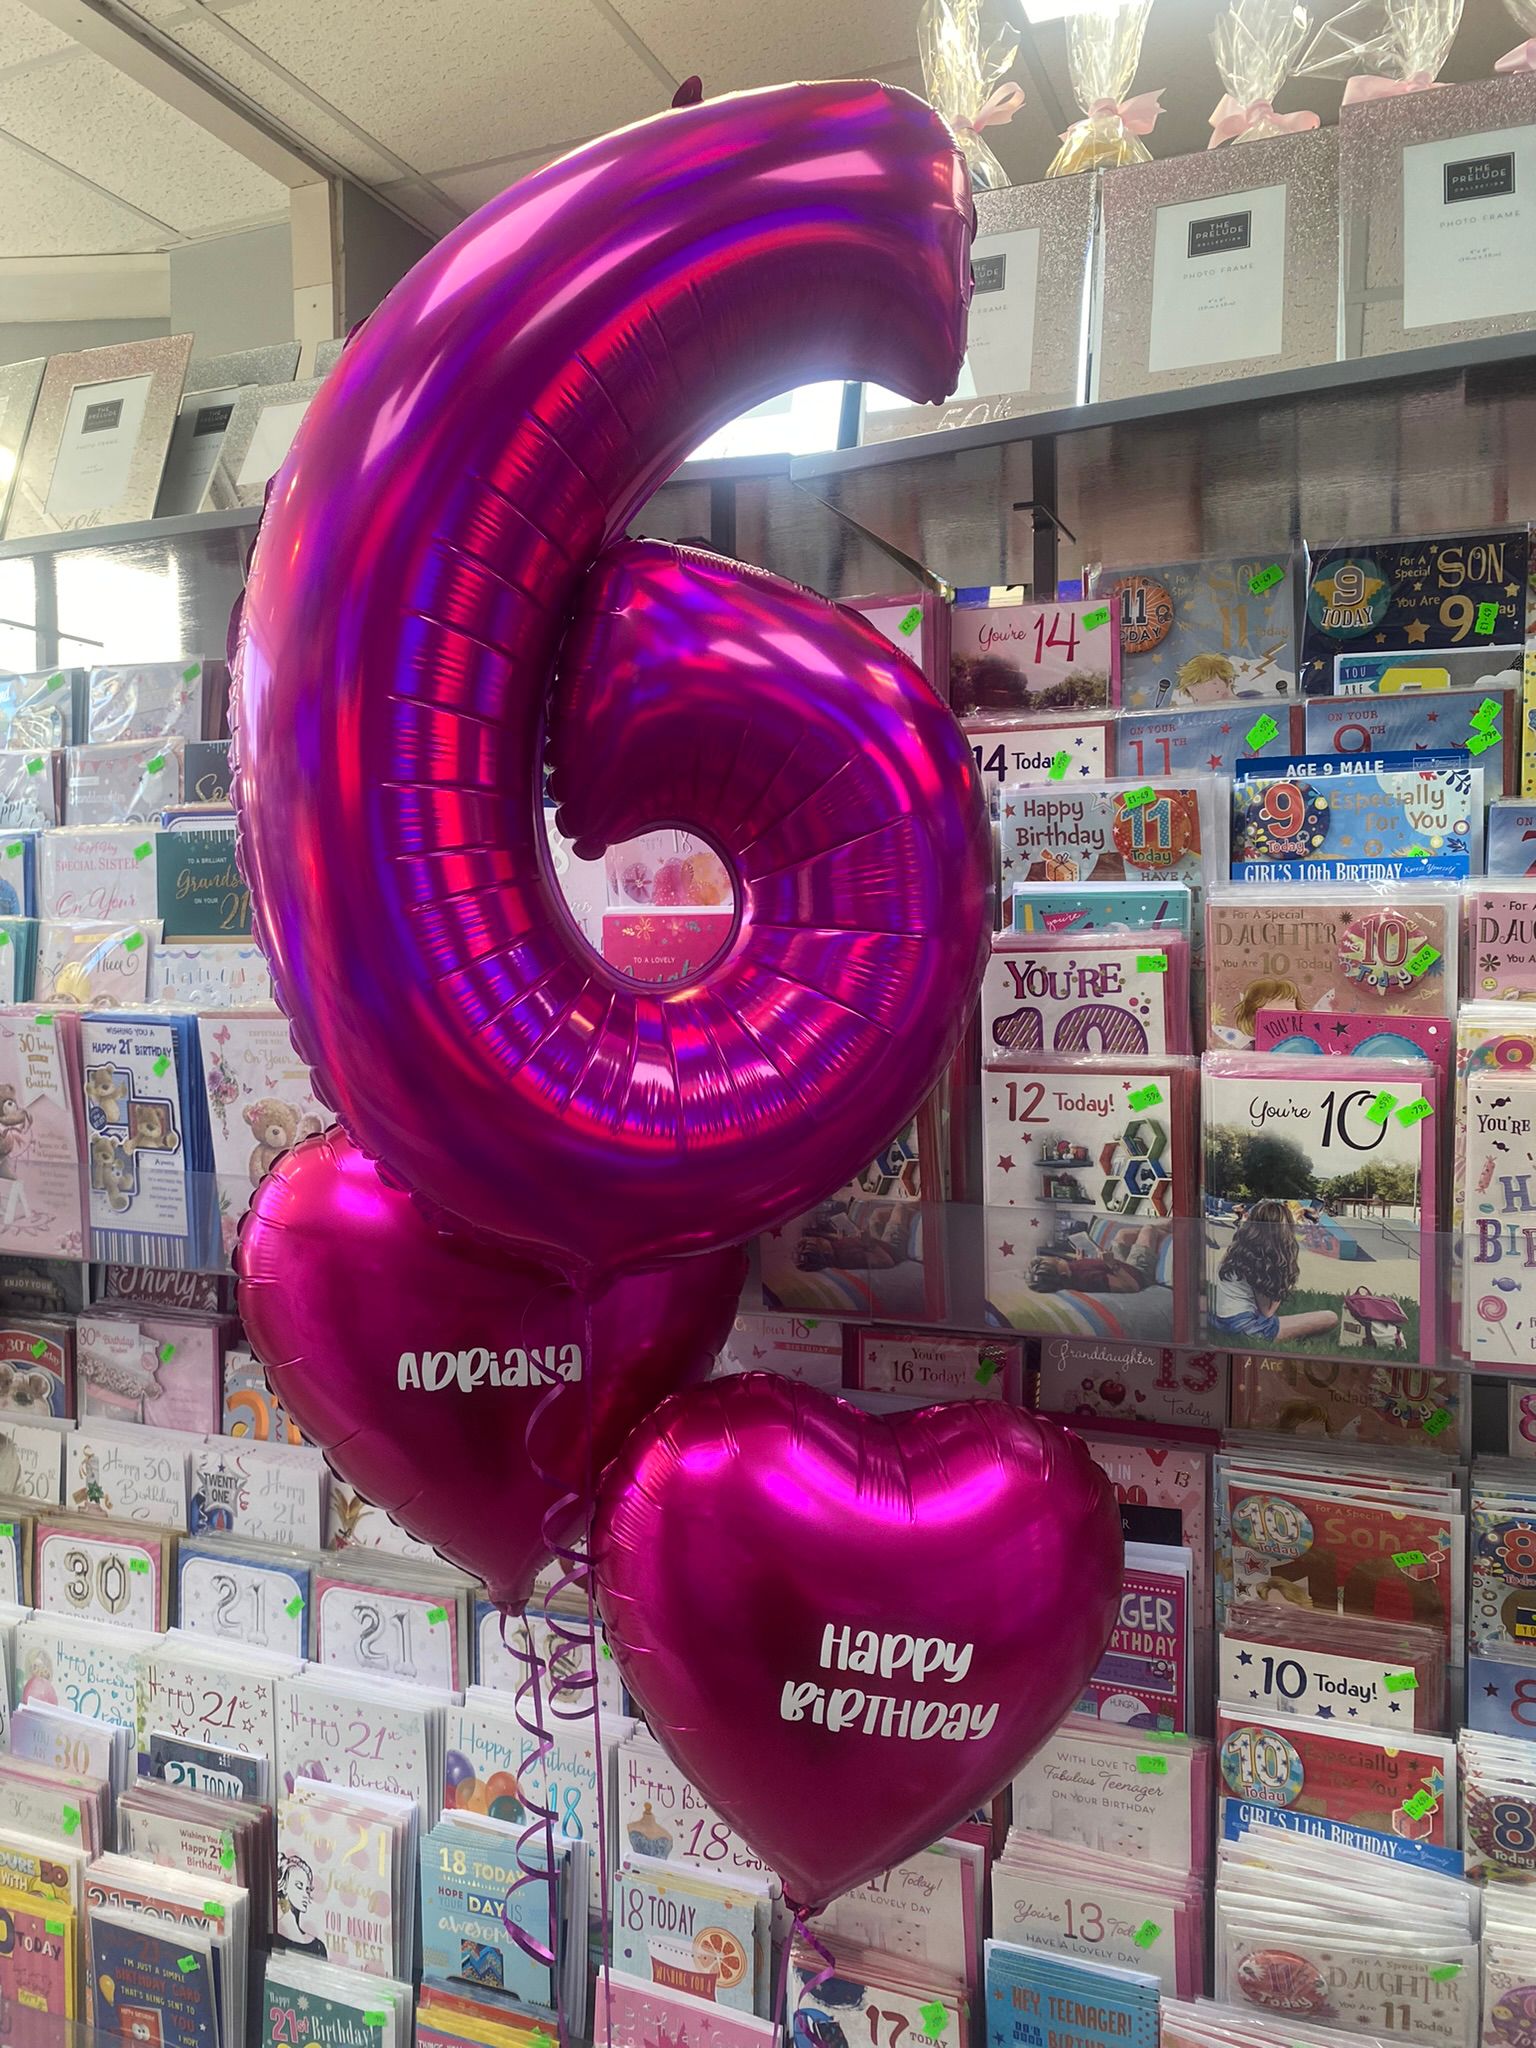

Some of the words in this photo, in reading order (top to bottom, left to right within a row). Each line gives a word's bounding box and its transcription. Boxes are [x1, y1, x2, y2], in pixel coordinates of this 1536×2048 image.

[1452, 168, 1506, 184] PRELUDE
[1468, 163, 1490, 173] THE
[1211, 221, 1229, 230] THE
[1440, 217, 1476, 228] PHOTO
[1483, 210, 1520, 220] FRAME
[1195, 226, 1243, 239] PRELUDE
[1183, 269, 1215, 279] PHOTO
[1221, 263, 1253, 272] FRAME
[1395, 566, 1430, 580] Special
[1400, 557, 1415, 565] For
[1437, 543, 1506, 588] SON
[1333, 566, 1365, 606] 9
[1321, 607, 1373, 627] TODAY
[1397, 597, 1417, 607] You
[1420, 596, 1440, 605] Are
[1440, 595, 1474, 642] 9
[979, 624, 1026, 651] You're
[1034, 612, 1080, 663] 14
[1345, 666, 1366, 677] YOU
[1345, 685, 1363, 694] ARE
[1346, 711, 1378, 720] YOUR
[1130, 725, 1149, 736] ON
[1152, 724, 1176, 734] YOUR
[1287, 763, 1319, 777] AGE
[1323, 762, 1333, 775] 9
[1340, 760, 1383, 774] MALE
[1331, 785, 1444, 810] Especially
[1024, 800, 1083, 826] Happy
[1264, 783, 1305, 838] 9
[1365, 812, 1399, 832] For
[1410, 811, 1447, 829] You
[1517, 817, 1532, 825] ON
[1121, 800, 1171, 848] 11
[1016, 827, 1105, 849] Birthday
[1267, 840, 1305, 853] Today
[56, 859, 96, 872] SPECIAL
[1131, 849, 1171, 864] Today
[1142, 872, 1179, 881] HAVE
[1245, 865, 1292, 881] GIRL'S
[1299, 865, 1330, 881] 10th
[1336, 863, 1403, 881] BIRTHDAY
[1232, 911, 1247, 919] For
[1265, 910, 1304, 922] Special
[1509, 901, 1528, 910] For
[1217, 922, 1337, 951] DAUGHTER
[1361, 919, 1408, 967] 10
[1222, 960, 1238, 968] You
[1260, 952, 1290, 975] 10
[1296, 959, 1333, 972] Today
[1507, 954, 1524, 963] You
[1004, 960, 1122, 1000] YOU'RE
[1357, 966, 1413, 988] Today
[106, 1028, 132, 1036] WISHING
[135, 1028, 148, 1036] YOU
[1264, 1016, 1303, 1038] YOU'RE
[93, 1043, 116, 1053] HAPPY
[135, 1046, 171, 1057] BIRTHDAY
[1005, 1082, 1050, 1122] 12
[1053, 1092, 1115, 1117] Today!
[1249, 1096, 1311, 1127] You're
[1320, 1090, 1387, 1151] 10
[1477, 1115, 1530, 1135] YOU'RE
[5, 1280, 28, 1288] ENJOY
[103, 1335, 134, 1346] Birthday
[785, 1344, 829, 1352] BIRTHDAY
[1049, 1339, 1158, 1372] Granddaughter
[891, 1361, 914, 1383] 16
[919, 1366, 966, 1385] Today!
[1162, 1395, 1211, 1425] Today
[103, 1449, 141, 1479] Happy
[204, 1473, 240, 1489] TWENTY
[259, 1471, 305, 1503] Happy
[117, 1479, 179, 1516] Birthday
[211, 1489, 229, 1501] ONE
[1239, 1503, 1300, 1543] 10
[1316, 1504, 1331, 1513] For
[1347, 1509, 1384, 1520] Special
[1324, 1518, 1400, 1551] Son
[1258, 1542, 1298, 1556] Today
[64, 1551, 131, 1615] 30
[209, 1575, 267, 1646] 21
[352, 1602, 417, 1678] 21
[57, 1640, 86, 1675] Happy
[820, 1623, 974, 1683] Happy
[87, 1664, 135, 1702] Birthday
[149, 1665, 195, 1717] Happy
[1262, 1657, 1307, 1698] 10
[1314, 1673, 1377, 1703] Today!
[291, 1694, 339, 1746] Happy
[460, 1717, 512, 1768] Happy
[1057, 1752, 1086, 1763] WITH
[1091, 1759, 1118, 1769] LOVE
[1123, 1762, 1136, 1772] TO
[1228, 1732, 1289, 1788] 10
[203, 1775, 239, 1800] TODAY
[628, 1760, 674, 1808] Happy
[1043, 1765, 1096, 1785] Fabulous
[1098, 1771, 1164, 1802] Teenager
[1243, 1785, 1286, 1806] Today
[1052, 1790, 1067, 1799] ON
[1072, 1794, 1097, 1805] YOUR
[1102, 1798, 1155, 1814] BIRTHDAY
[180, 1829, 205, 1843] Wishing
[683, 1820, 732, 1860] 18
[1239, 1805, 1286, 1828] GIRL'S
[1331, 1822, 1398, 1858] BIRTHDAY
[181, 1841, 207, 1855] Happy
[187, 1857, 222, 1874] Birthday
[439, 1847, 466, 1875] 18
[473, 1862, 527, 1883] TODAY
[438, 1886, 464, 1899] HOPE
[899, 1868, 943, 1896] Today!
[469, 1897, 505, 1917] DAY
[620, 1886, 643, 1931] 18
[648, 1896, 696, 1936] TODAY
[871, 1895, 906, 1909] LOVELY
[911, 1904, 931, 1914] DAY
[325, 1910, 342, 1931] YOU
[347, 1917, 383, 1944] DESERVE
[1064, 1899, 1105, 1942] 13
[15, 1931, 60, 1960] TODAY
[326, 1933, 348, 1952] THE
[355, 1945, 384, 1962] BEST
[1026, 1933, 1055, 1947] HAVE
[1073, 1943, 1113, 1958] LOVELY
[1118, 1953, 1141, 1964] DAY
[137, 1961, 152, 1973] JUST
[163, 1970, 185, 1983] SIMPLE
[656, 1966, 687, 1987] WISHING
[1352, 1958, 1371, 1967] For
[1386, 1961, 1428, 1973] Special
[121, 1986, 143, 1999] THAT'S
[168, 2000, 182, 2011] SENT
[1259, 1993, 1313, 2009] Today
[866, 2004, 909, 2048] 17
[1048, 1996, 1132, 2038] TEENAGER!
[1339, 2001, 1359, 2011] You
[1380, 2001, 1411, 2031] 11
[1414, 2020, 1452, 2036] Today
[311, 2015, 374, 2046] Birthday!
